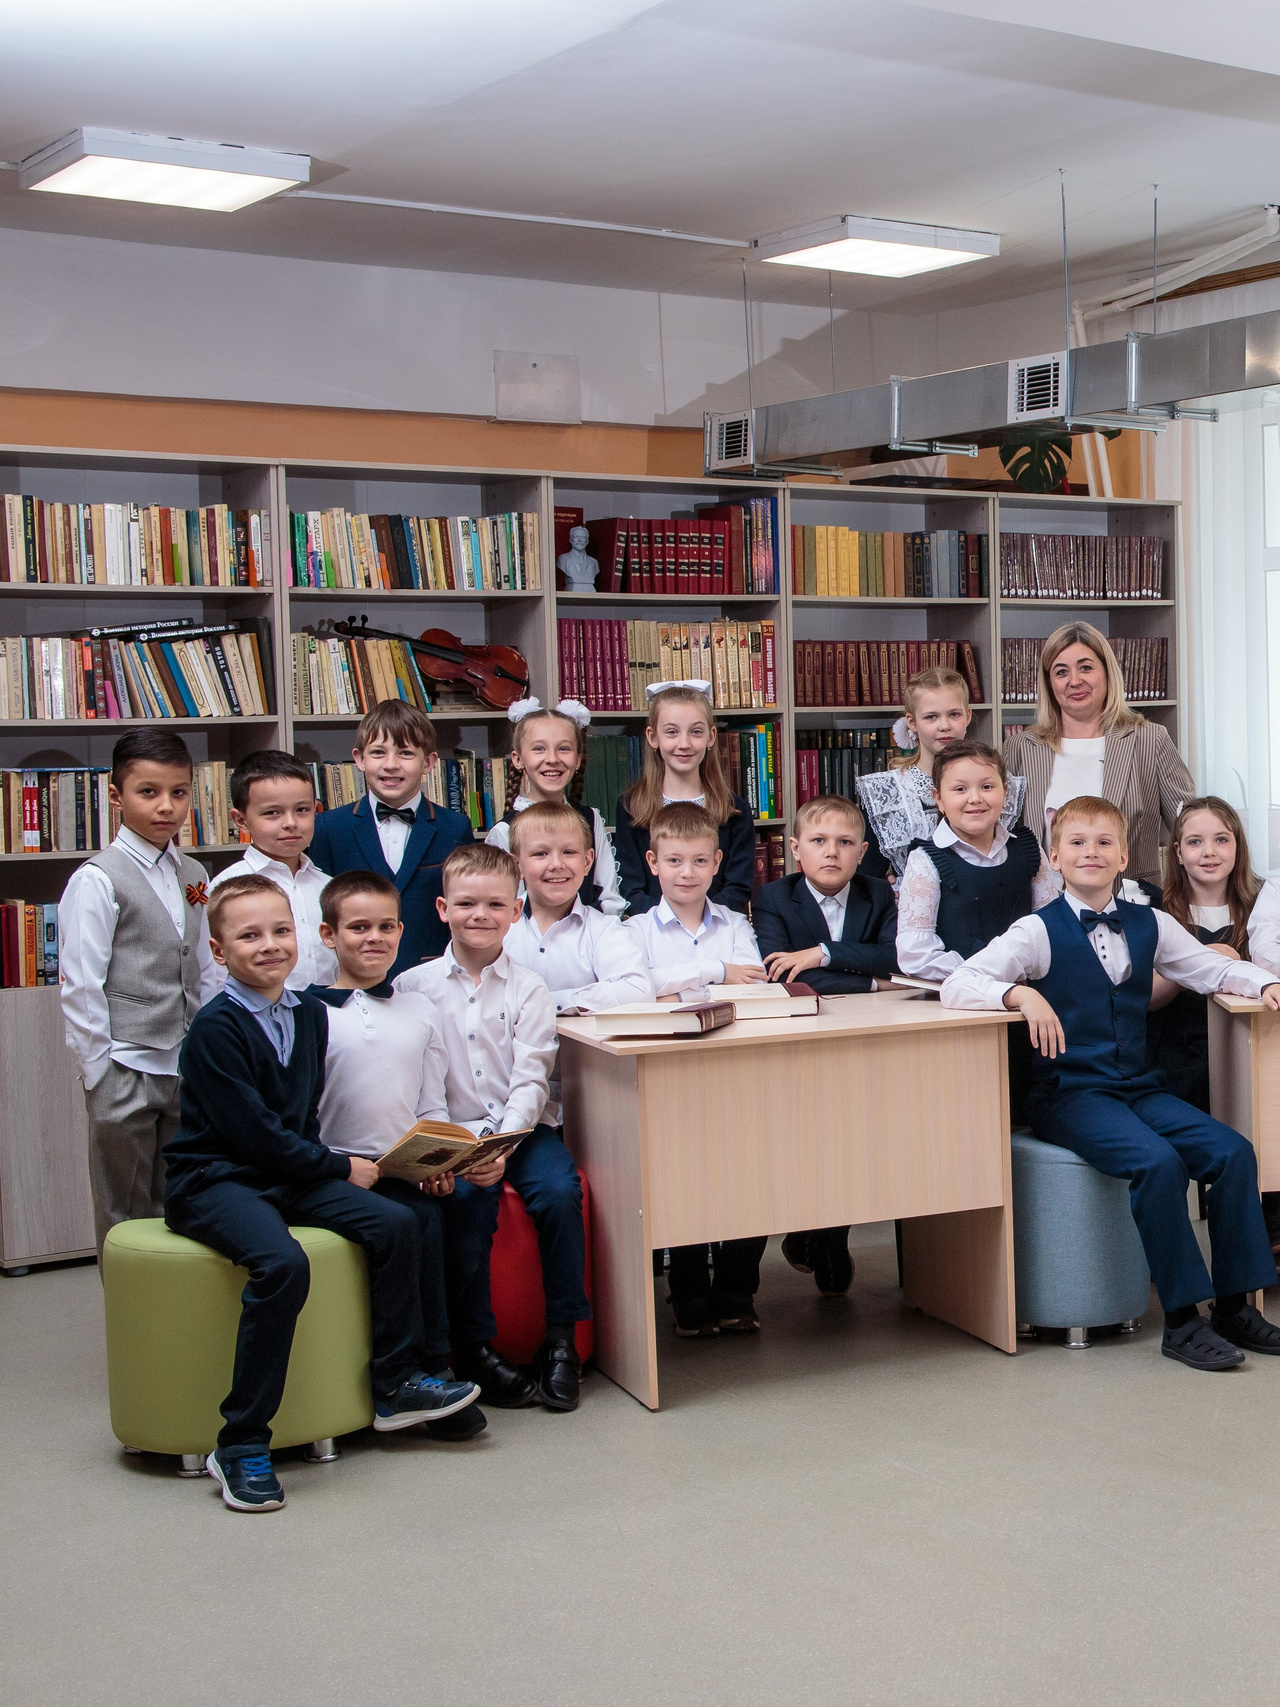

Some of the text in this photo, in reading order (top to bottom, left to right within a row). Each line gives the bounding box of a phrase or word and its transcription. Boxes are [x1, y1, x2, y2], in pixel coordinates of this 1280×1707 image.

[313, 518, 322, 557] ПЛУТАРХ
[131, 623, 157, 631] история
[157, 620, 179, 629] России
[151, 625, 225, 639] Военная история России
[214, 645, 226, 668] ТИТАН
[96, 657, 104, 707] ФАУСТ
[302, 672, 310, 706] СТЕНДАЛЬ
